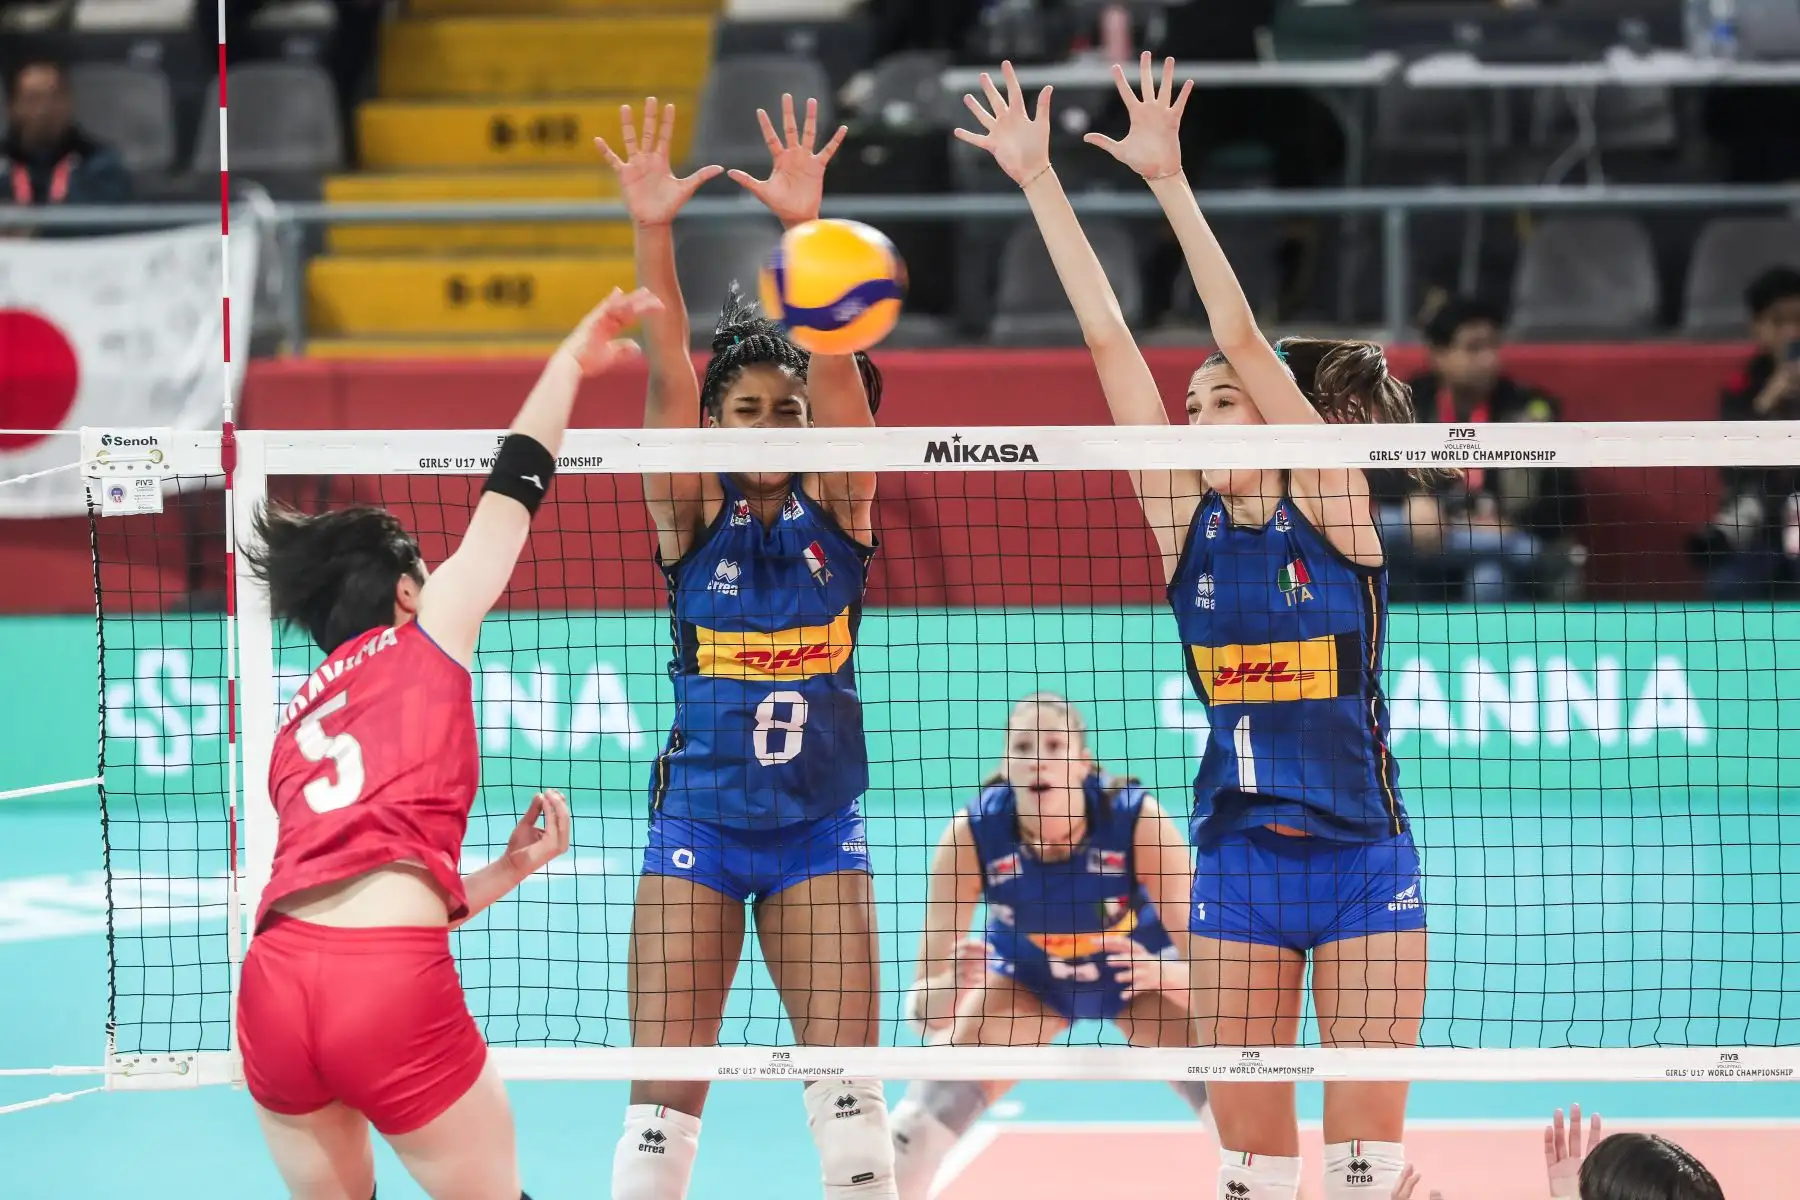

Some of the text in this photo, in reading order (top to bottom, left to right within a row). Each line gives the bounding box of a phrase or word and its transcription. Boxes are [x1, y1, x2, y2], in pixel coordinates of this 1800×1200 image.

[1448, 428, 1476, 438] FIVB
[113, 435, 158, 446] Senoh
[455, 458, 475, 468] U17
[556, 456, 603, 468] IONSHIP
[1369, 451, 1557, 461] GIRLS' U17 WORLD CHAMPIONSHIP
[813, 568, 834, 586] TA
[1285, 587, 1315, 607] ITA
[734, 641, 834, 670] DHL
[1213, 661, 1297, 686] DHL
[752, 690, 809, 767] 8
[295, 690, 365, 814] 5
[1233, 715, 1258, 794] 1
[1387, 897, 1420, 911] errea
[771, 1051, 791, 1059] FIVB
[1720, 1053, 1739, 1061] FIVB
[742, 1067, 757, 1075] U17
[760, 1067, 786, 1075] WORLD
[788, 1067, 845, 1075] CHAMPIONSHIP
[1212, 1066, 1227, 1074] U17
[1229, 1066, 1256, 1074] WORLD
[1257, 1066, 1315, 1075] CHAMPIONSHIP
[1690, 1069, 1705, 1077] U17
[1707, 1069, 1734, 1077] WORLD
[1736, 1069, 1794, 1077] CHAMPIONSHIP
[835, 1107, 861, 1119] errea
[638, 1142, 665, 1154] errea
[1346, 1174, 1373, 1184] errea
